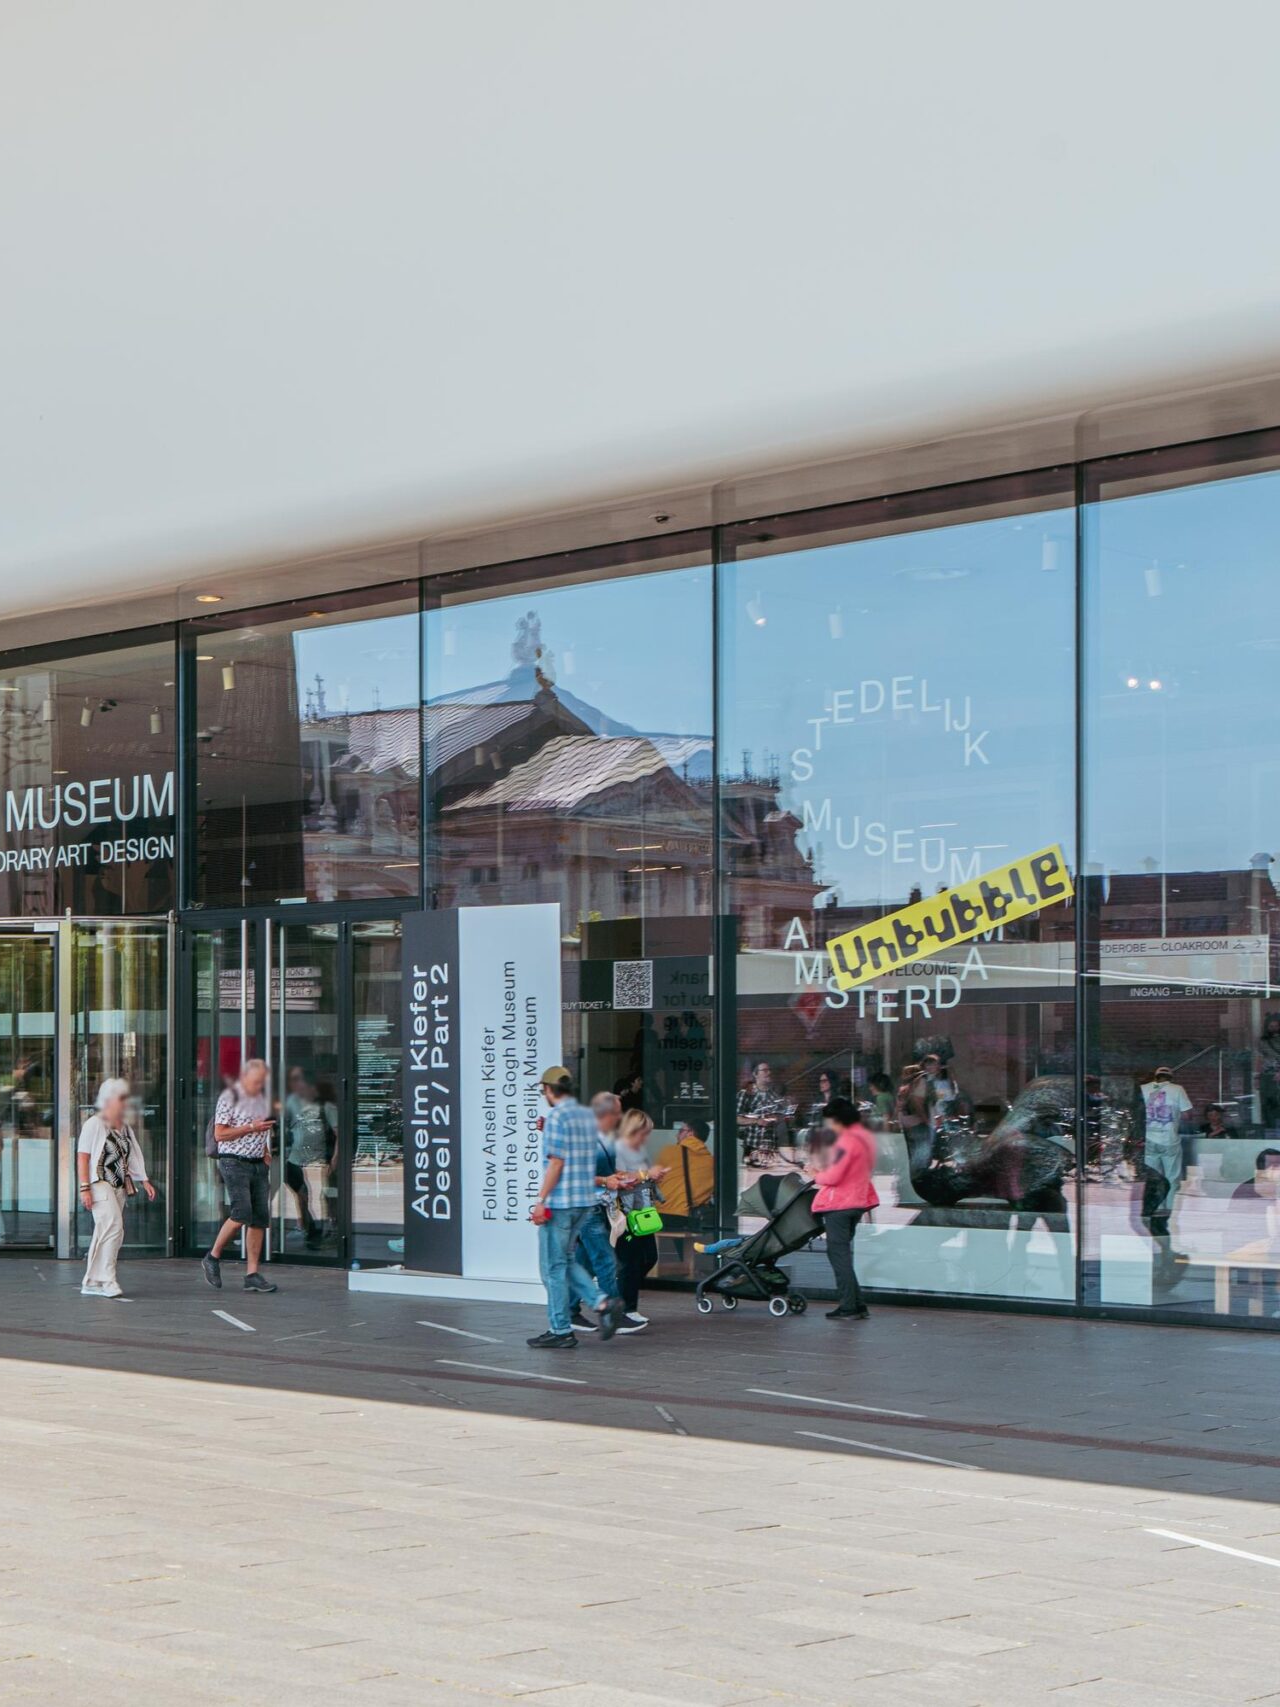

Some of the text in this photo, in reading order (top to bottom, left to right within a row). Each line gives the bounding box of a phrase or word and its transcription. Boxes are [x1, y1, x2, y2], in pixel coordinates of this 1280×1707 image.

[791, 675, 989, 782] STEDELIJK
[5, 771, 174, 833] MUSEUM
[55, 843, 92, 867] ART
[100, 834, 174, 864] DESIGN
[802, 798, 982, 883] MUSEUM
[430, 962, 449, 985] 2
[882, 962, 958, 977] WELCOME
[1160, 940, 1229, 952] CLOAKROOM
[1130, 987, 1170, 997] INGANG
[1185, 986, 1242, 996] ENTRANCE
[430, 995, 450, 1069] Part
[522, 996, 537, 1075] Museum
[409, 964, 430, 1219] Anselm Kiefer
[431, 1104, 450, 1126] 2
[480, 1026, 497, 1221] Follow Anselm Kiefer
[501, 961, 519, 1222] from the Van Gogh Museum
[523, 1083, 542, 1163] Stedelijk
[432, 1137, 451, 1220] Deel
[524, 1169, 539, 1199] the
